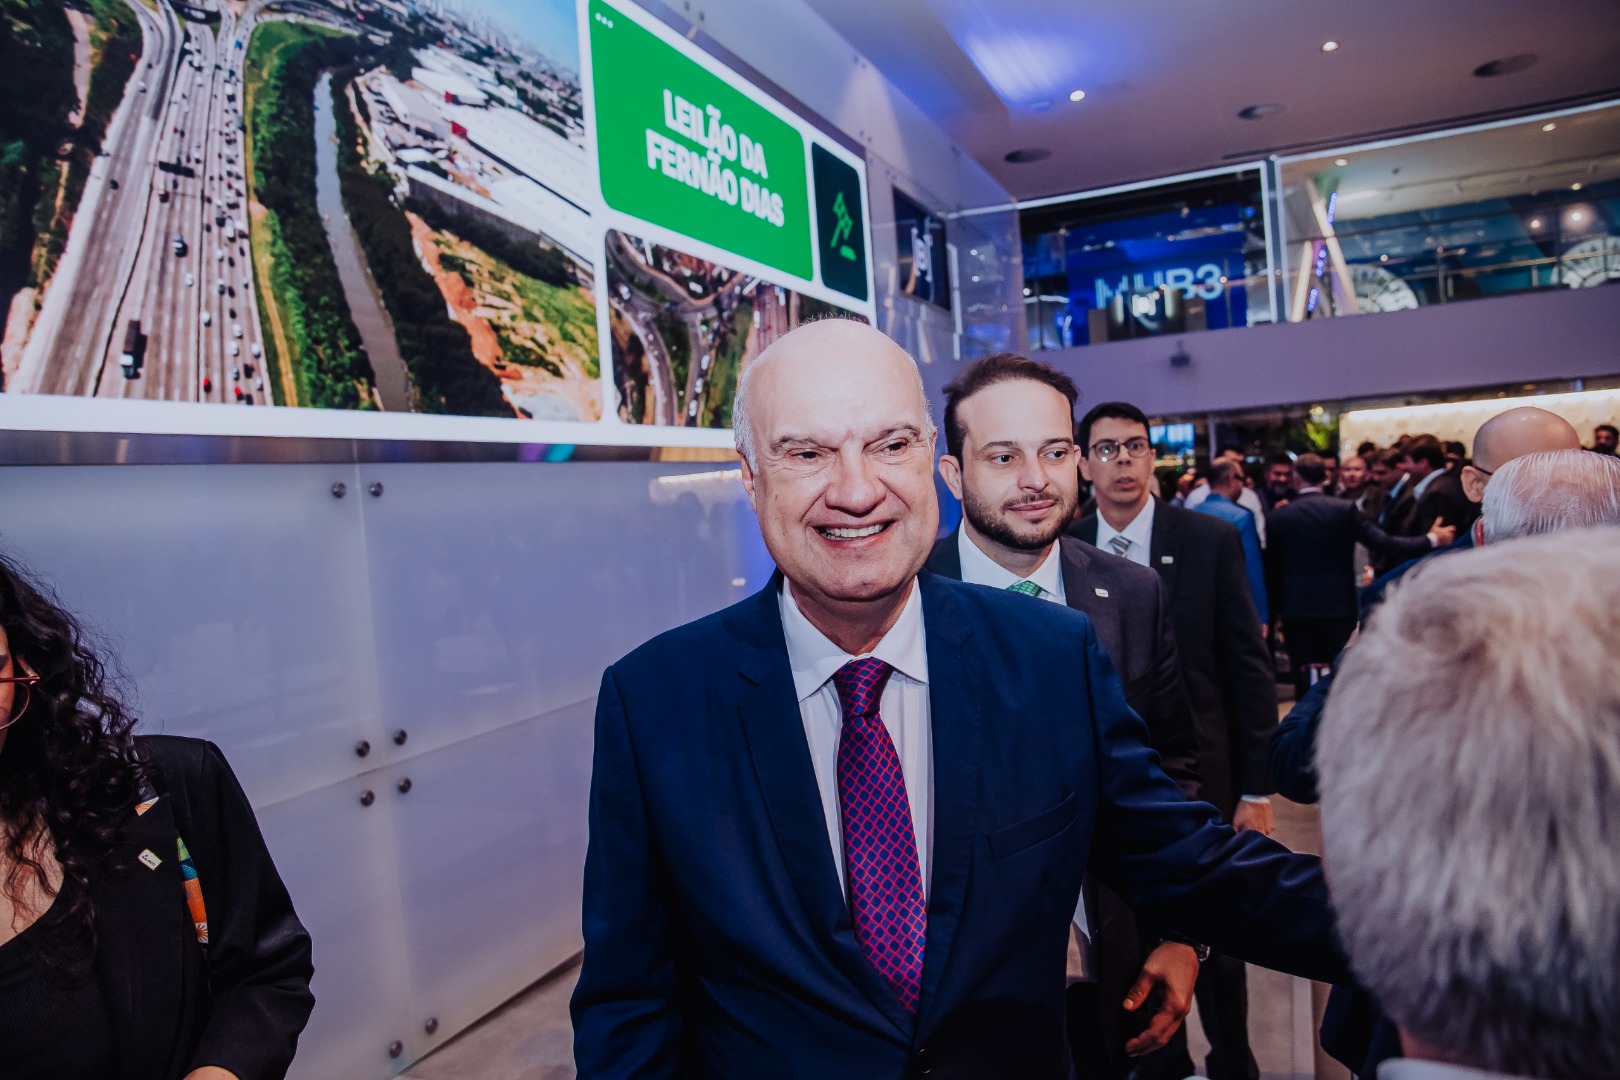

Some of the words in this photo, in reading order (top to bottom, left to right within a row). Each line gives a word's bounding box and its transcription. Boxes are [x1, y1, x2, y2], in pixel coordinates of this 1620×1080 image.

[645, 128, 739, 206] FERNÃO
[740, 176, 785, 228] DIAS
[663, 88, 738, 162] LEILÃO
[739, 133, 769, 180] DA
